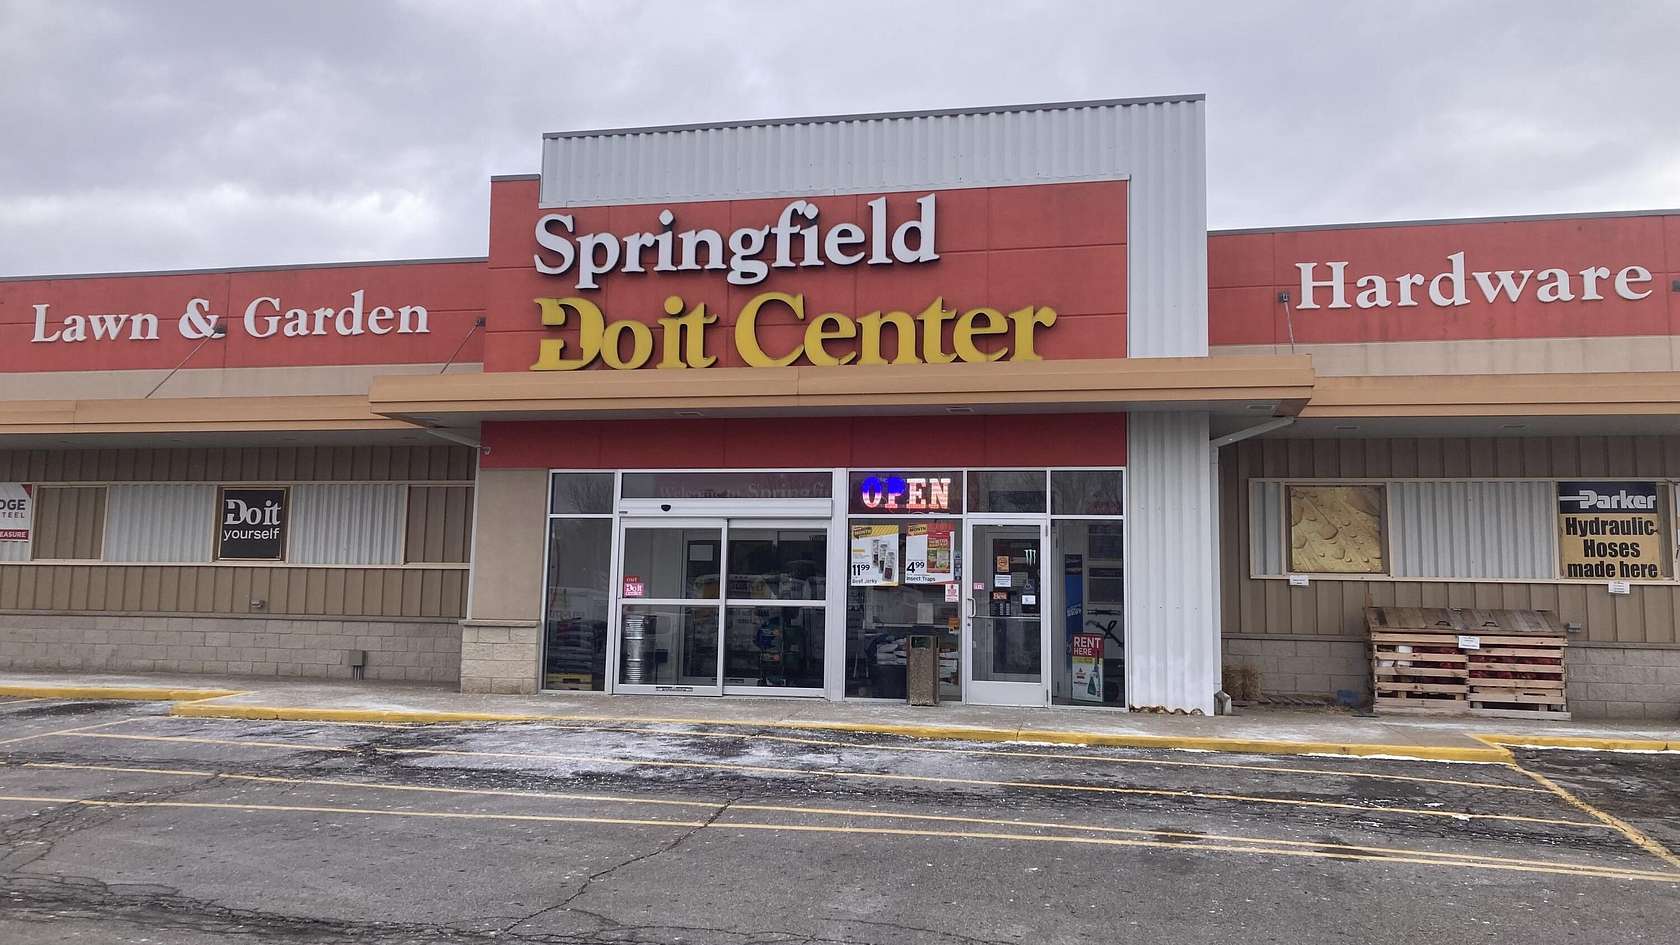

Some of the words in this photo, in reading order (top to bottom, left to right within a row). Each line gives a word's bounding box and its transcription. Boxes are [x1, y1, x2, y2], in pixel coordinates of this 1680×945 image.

[533, 193, 941, 289] Springfield
[1295, 251, 1653, 309] Hardware
[31, 303, 160, 343] Lawn
[179, 298, 226, 340] &
[244, 290, 431, 338] Garden
[735, 292, 1057, 368] Center
[862, 476, 951, 509] OPEN
[1579, 490, 1656, 509] Parker
[224, 528, 280, 541] yourself
[1565, 517, 1655, 537] Hydraulic
[1583, 539, 1640, 557] Hoses
[1567, 561, 1616, 577] made
[1620, 561, 1658, 577] here
[1073, 636, 1102, 649] RENT
[1073, 648, 1092, 656] HERE
